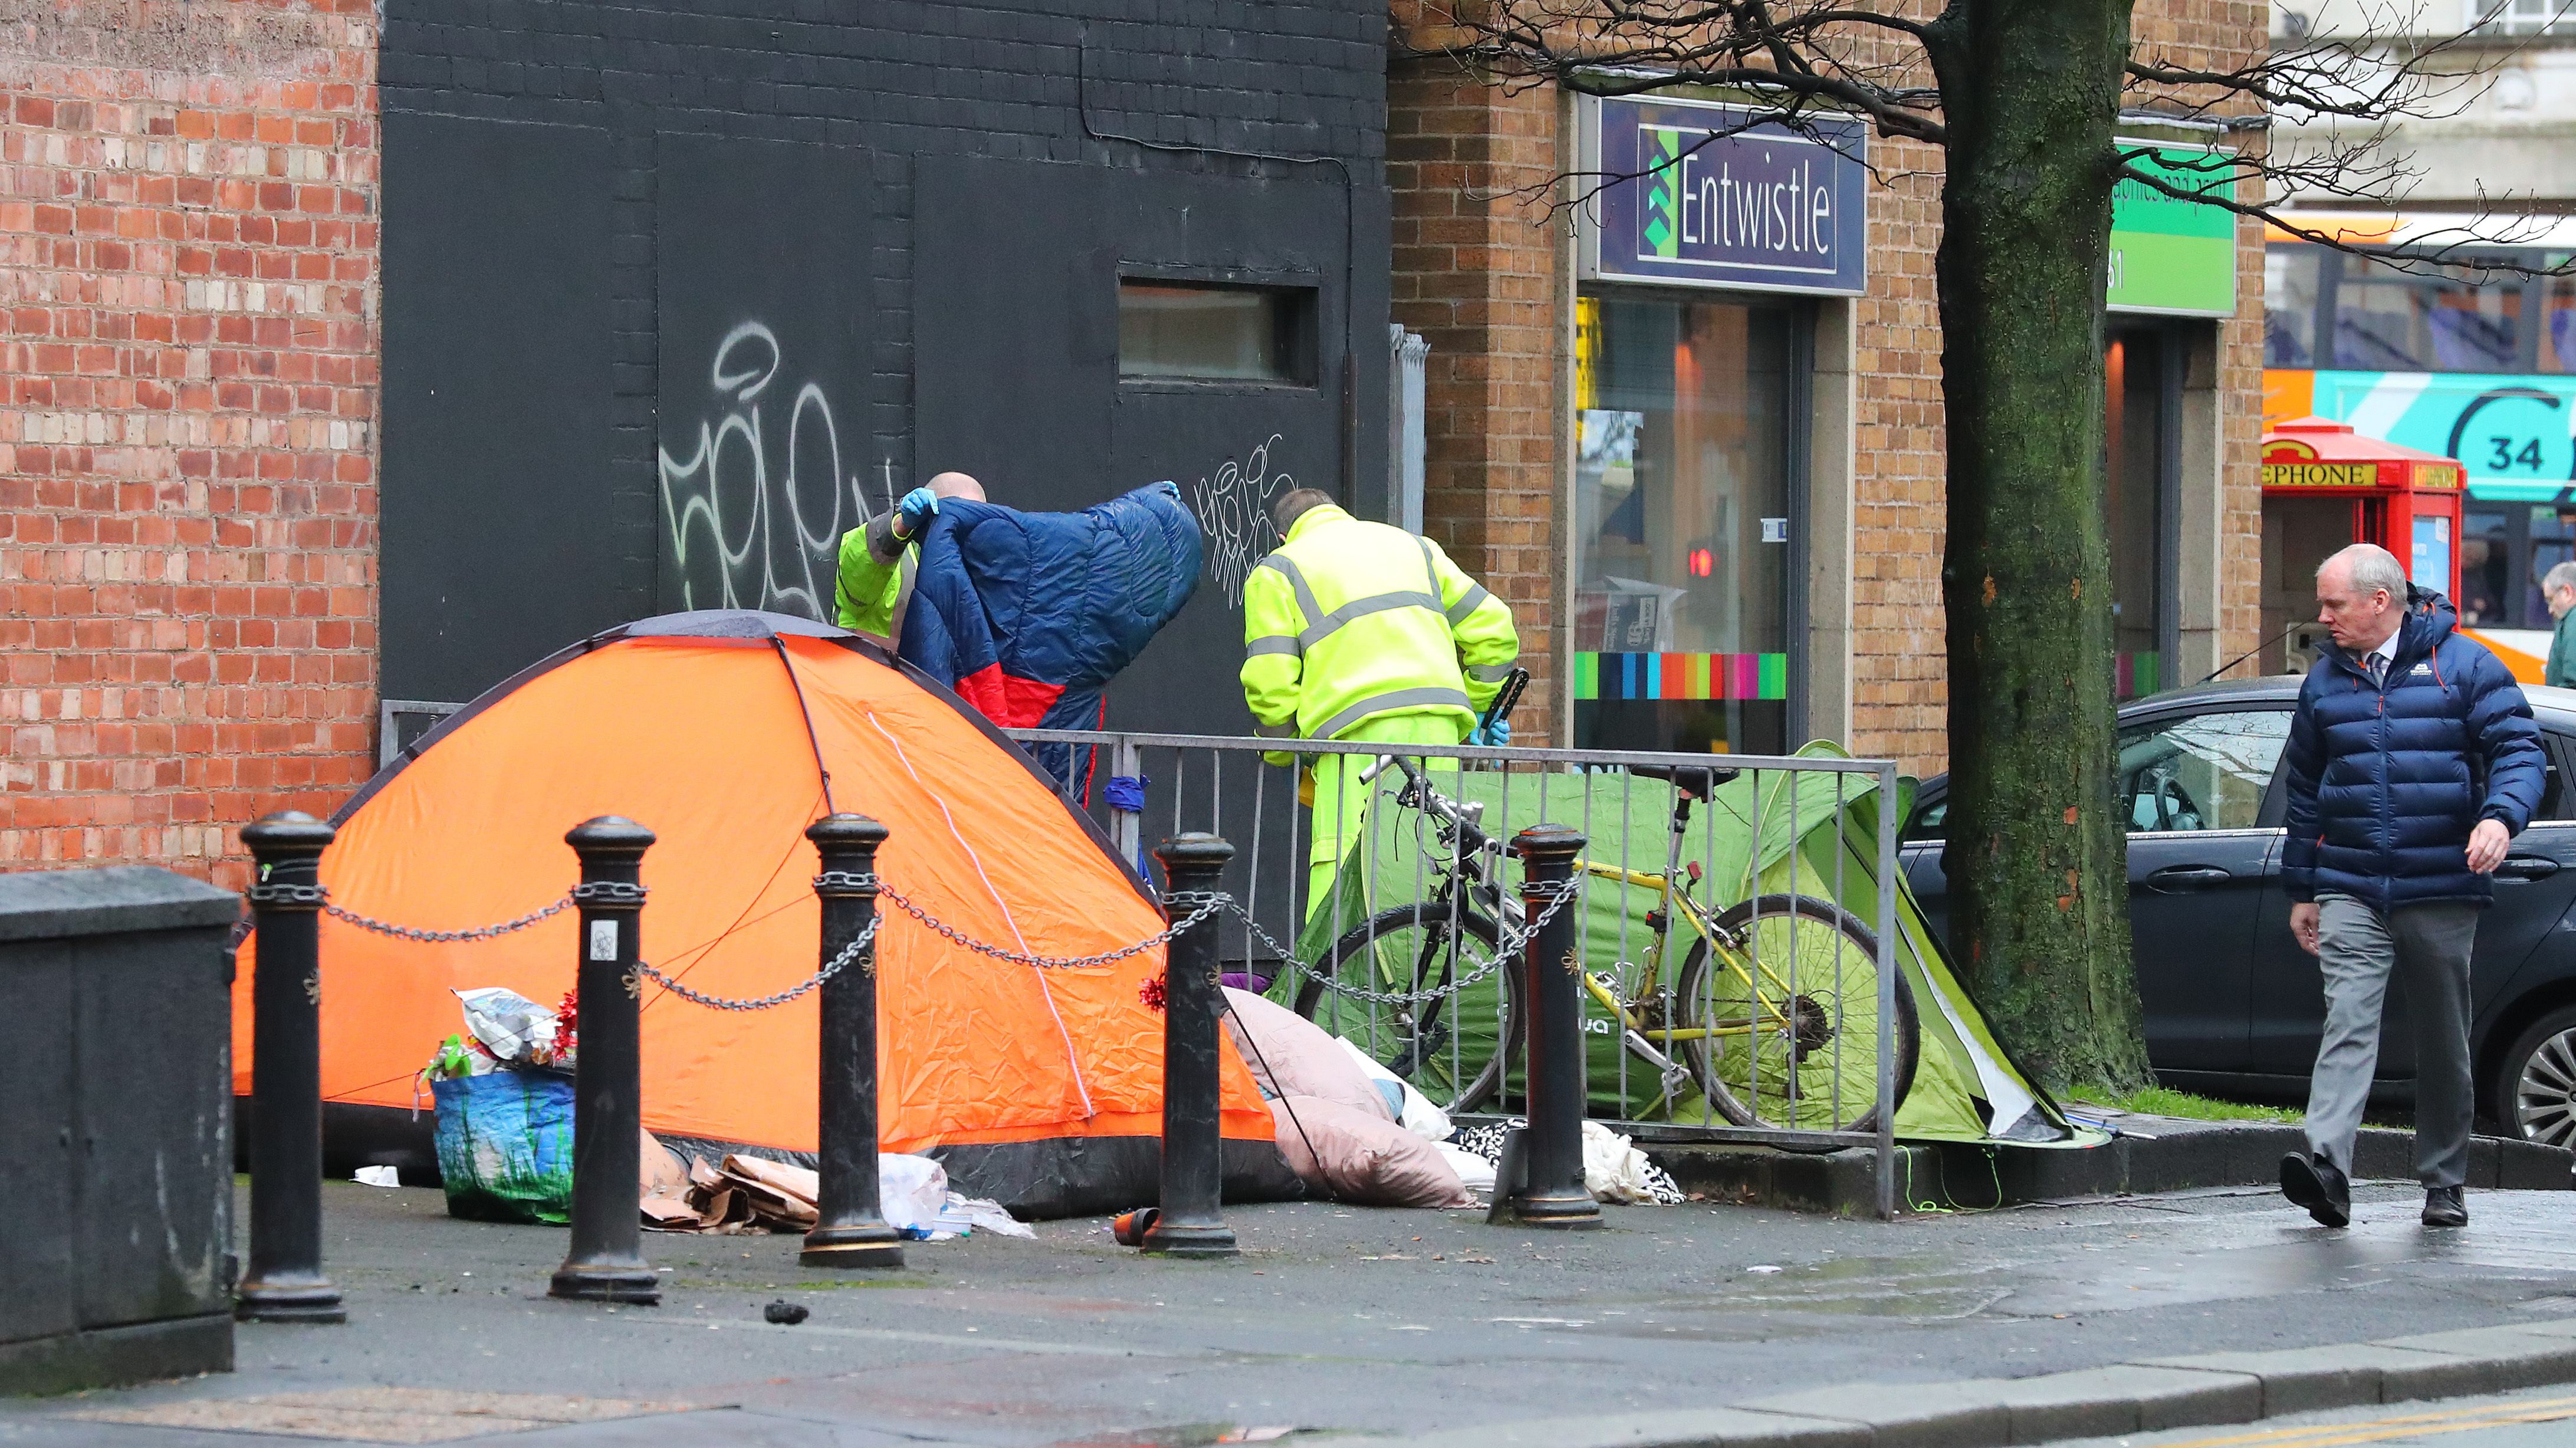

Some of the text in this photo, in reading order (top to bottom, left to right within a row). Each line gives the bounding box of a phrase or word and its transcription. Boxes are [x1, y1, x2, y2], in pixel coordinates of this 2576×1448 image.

[1683, 150, 1830, 255] Entwistle
[2488, 437, 2542, 470] 34
[2262, 465, 2364, 485] EPHONE
